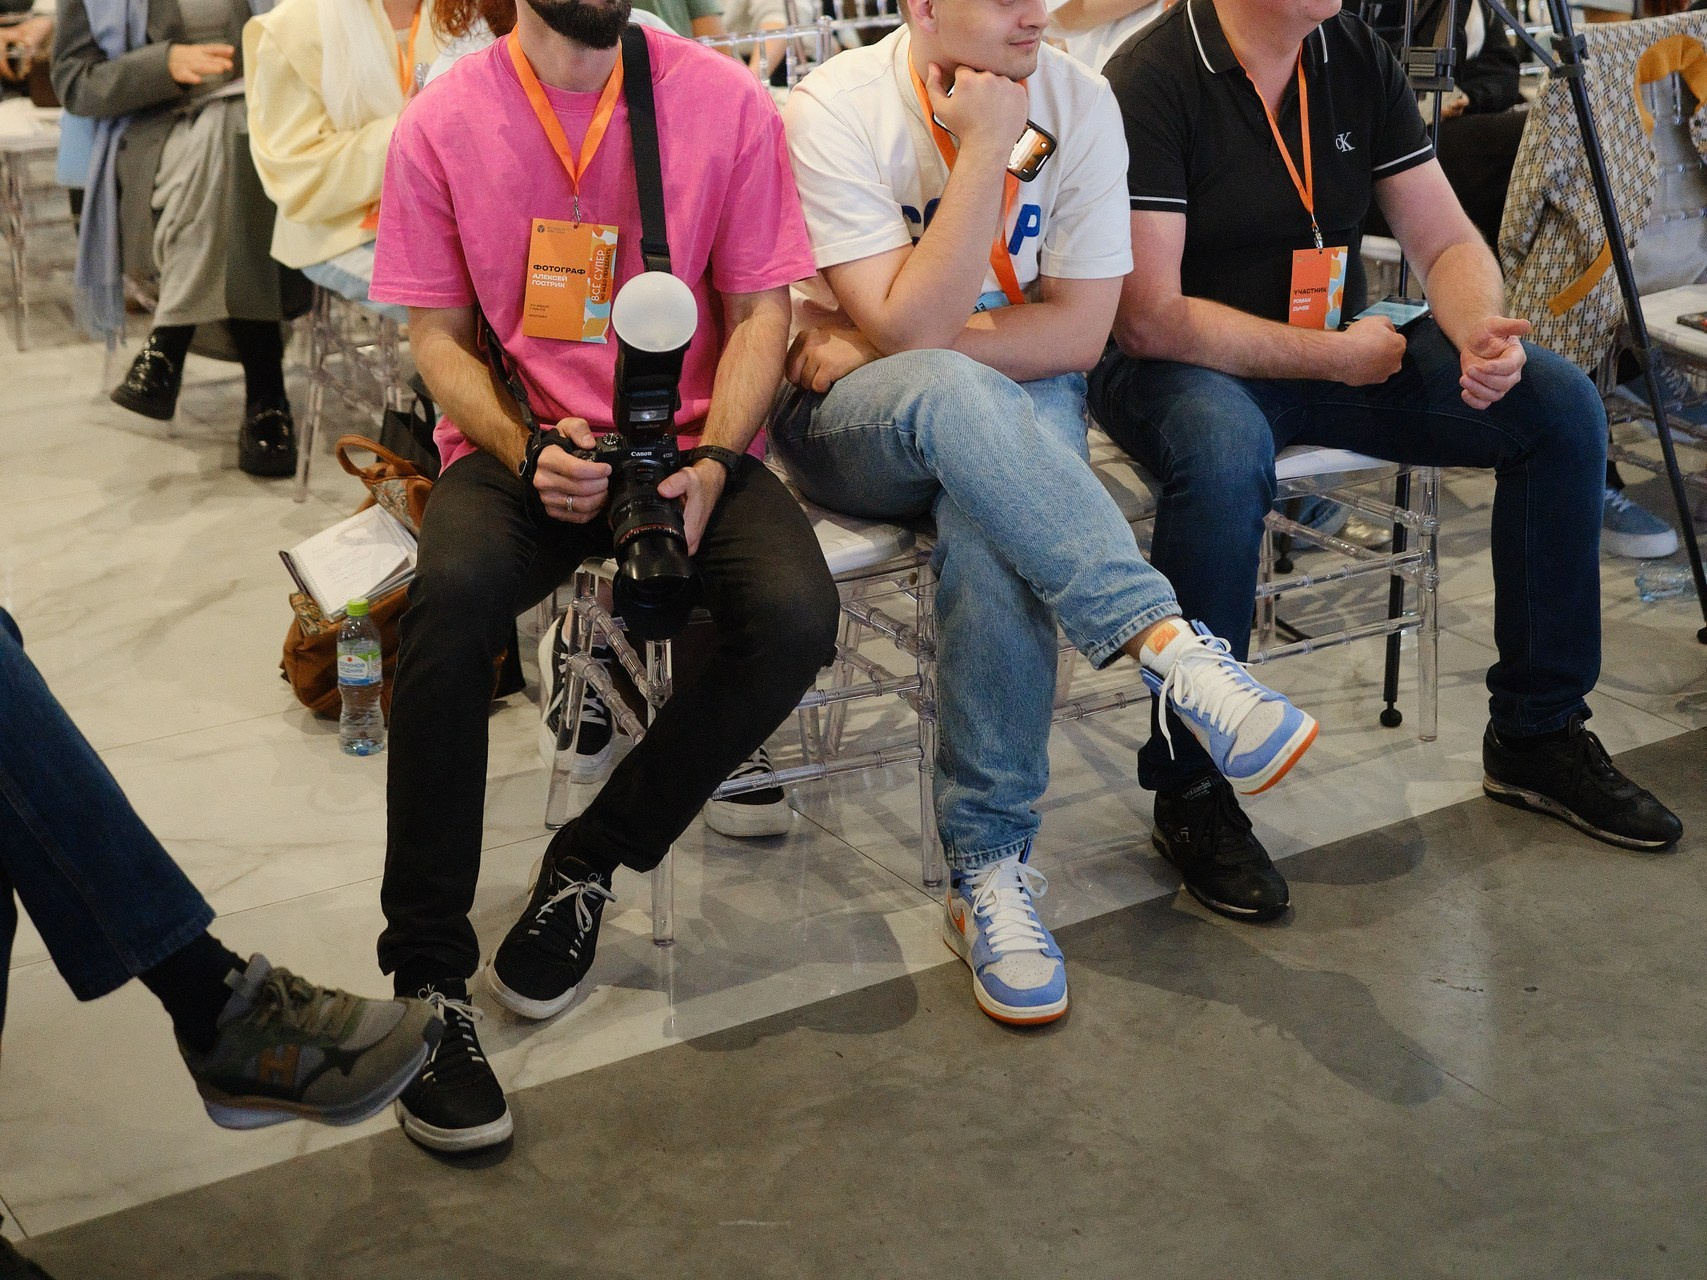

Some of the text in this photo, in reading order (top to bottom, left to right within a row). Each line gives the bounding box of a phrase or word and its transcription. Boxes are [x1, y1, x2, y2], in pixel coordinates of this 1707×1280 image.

[533, 264, 586, 275] ФОТОГРАФ
[532, 273, 568, 281] АЛЕКСЕЙ
[591, 249, 605, 301] ВСЕ СУПЕР
[1294, 287, 1328, 295] УЧАСТНИК
